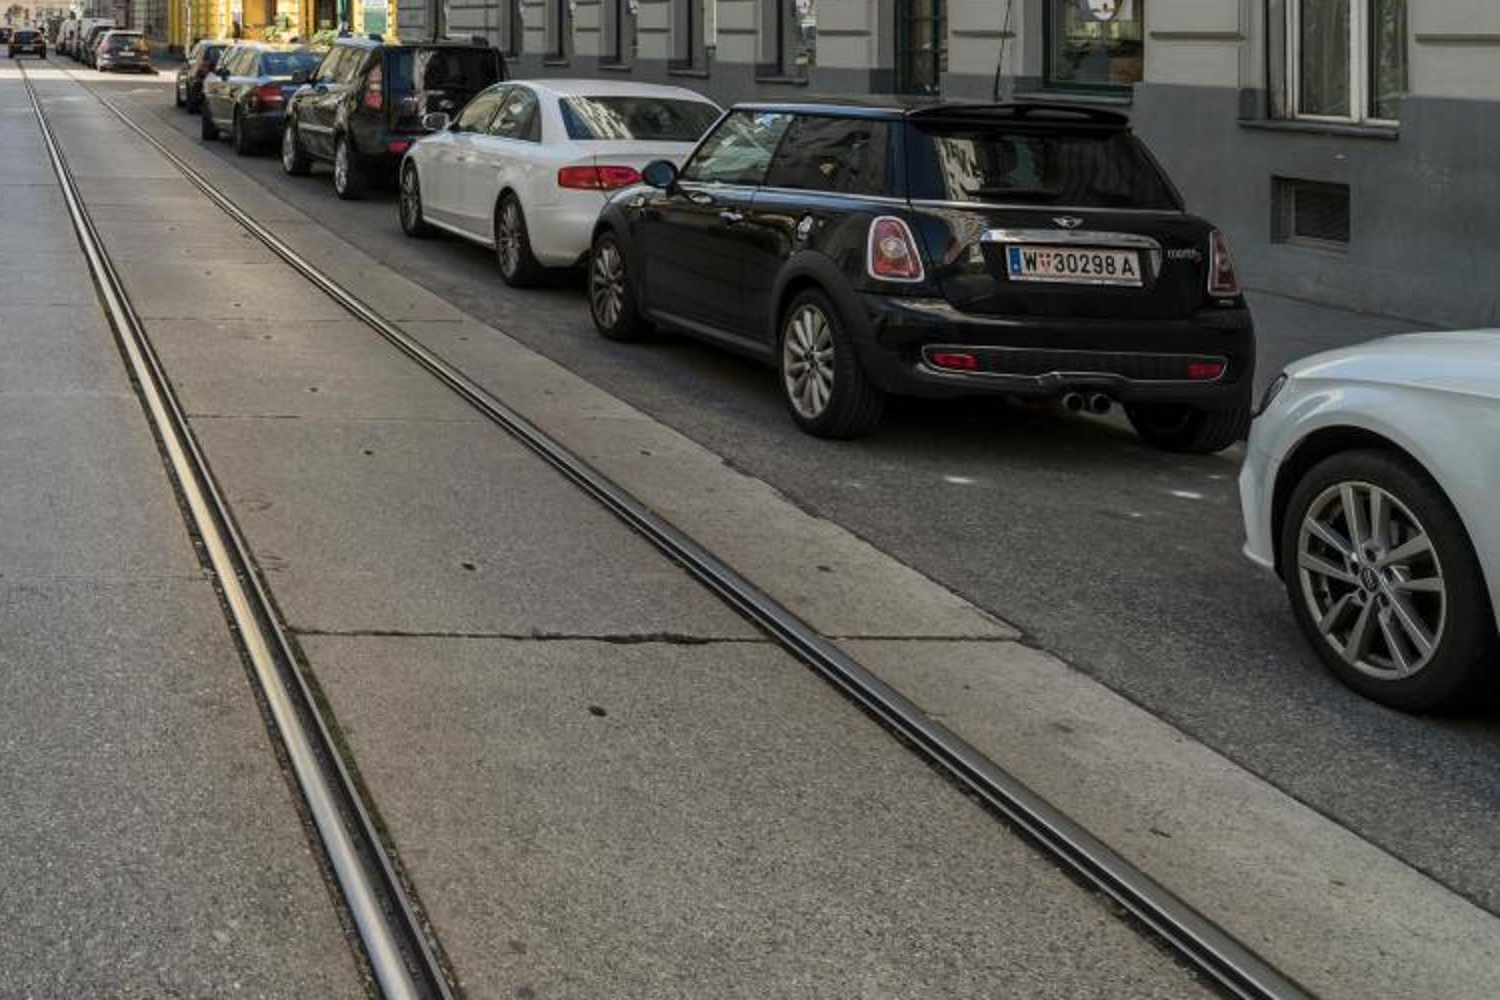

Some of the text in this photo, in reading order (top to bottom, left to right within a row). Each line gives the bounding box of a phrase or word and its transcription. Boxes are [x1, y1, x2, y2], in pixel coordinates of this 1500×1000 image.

[1023, 251, 1136, 276] W 30298 A
